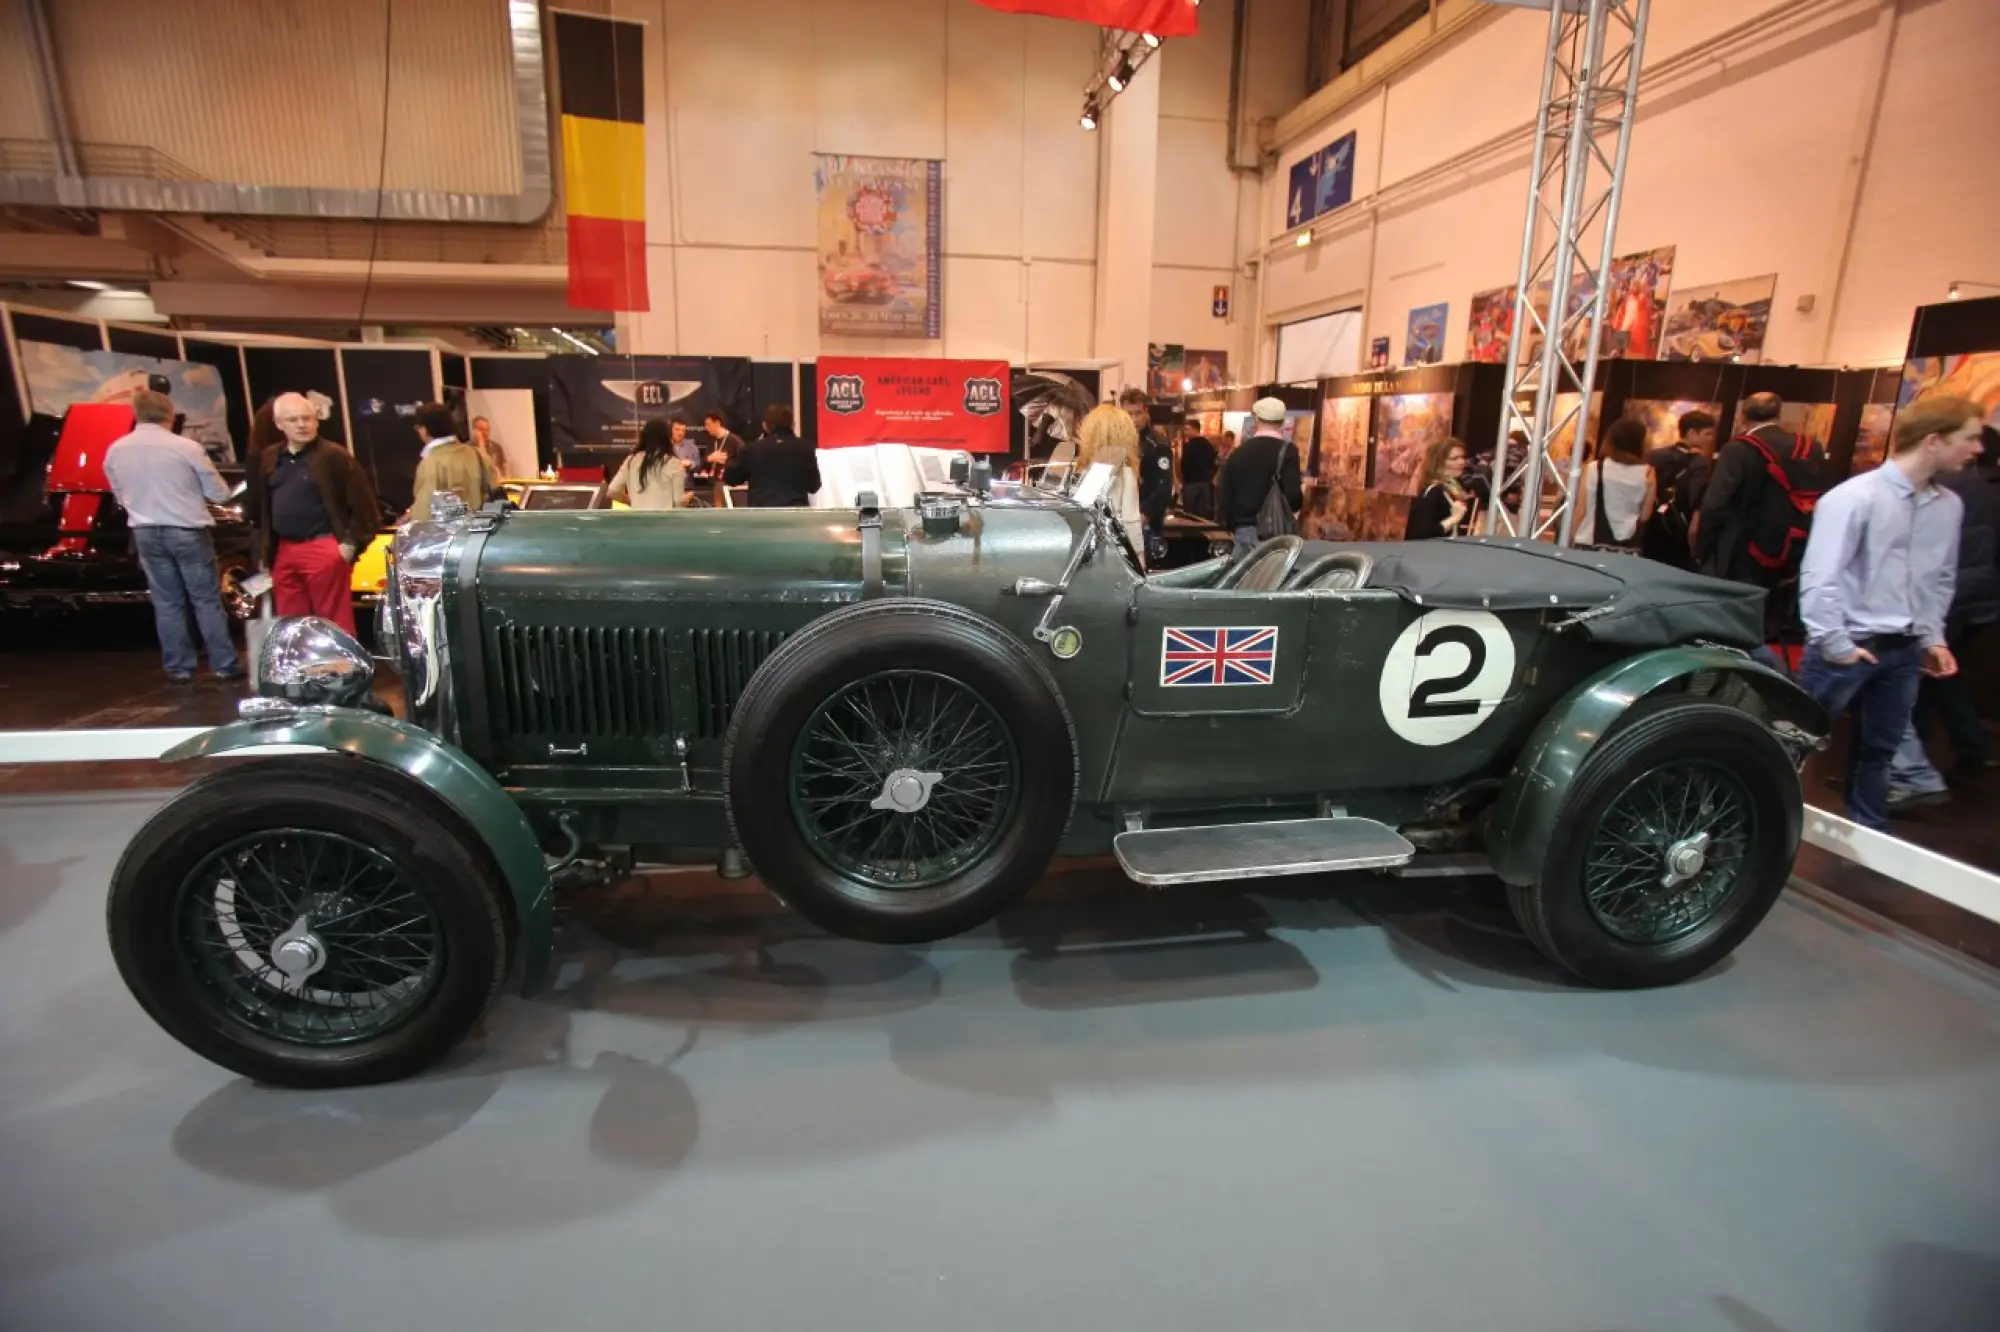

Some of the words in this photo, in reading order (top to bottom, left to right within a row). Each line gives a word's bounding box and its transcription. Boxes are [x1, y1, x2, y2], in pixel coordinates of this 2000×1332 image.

[1289, 186, 1303, 225] 4
[831, 382, 860, 399] ACL
[969, 385, 998, 401] ACL
[1407, 624, 1487, 719] 2
